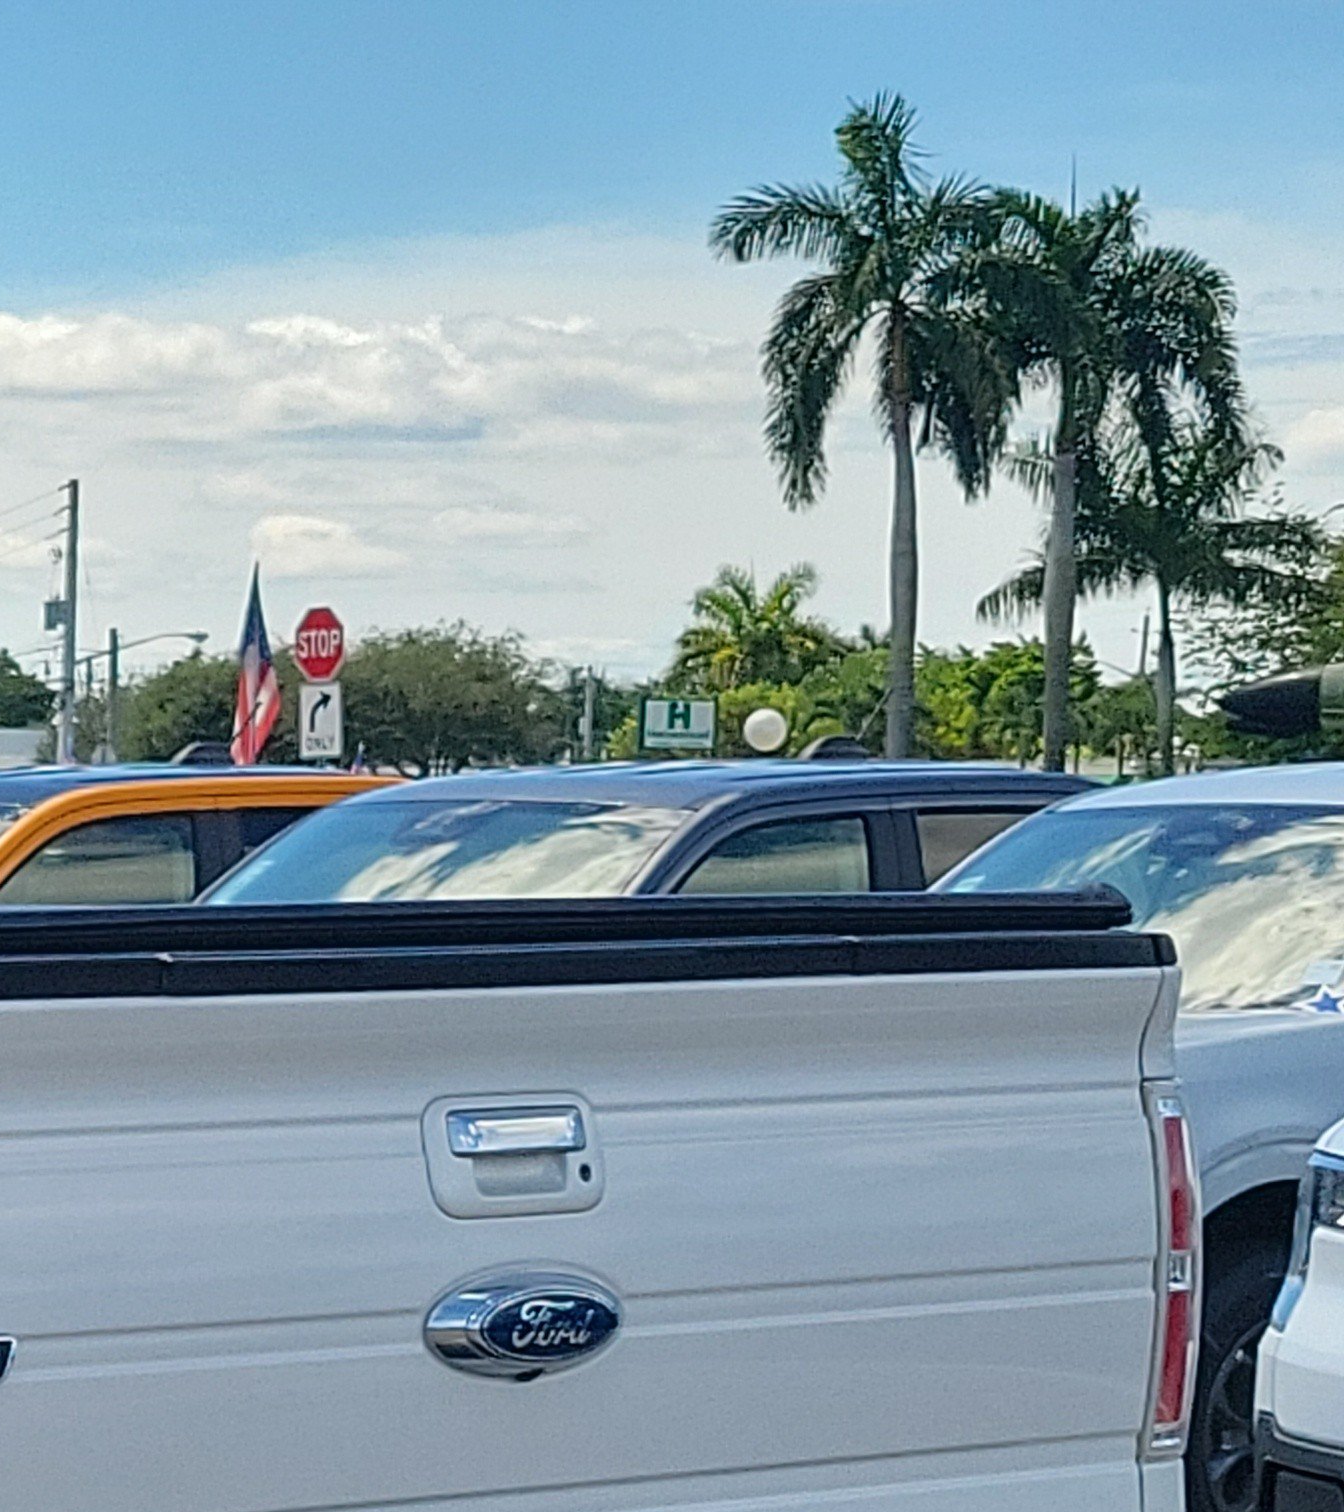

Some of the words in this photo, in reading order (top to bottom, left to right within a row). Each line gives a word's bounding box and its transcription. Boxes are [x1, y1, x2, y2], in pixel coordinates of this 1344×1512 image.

[298, 629, 340, 658] STOP
[668, 702, 691, 729] H
[512, 1300, 595, 1348] Ford
